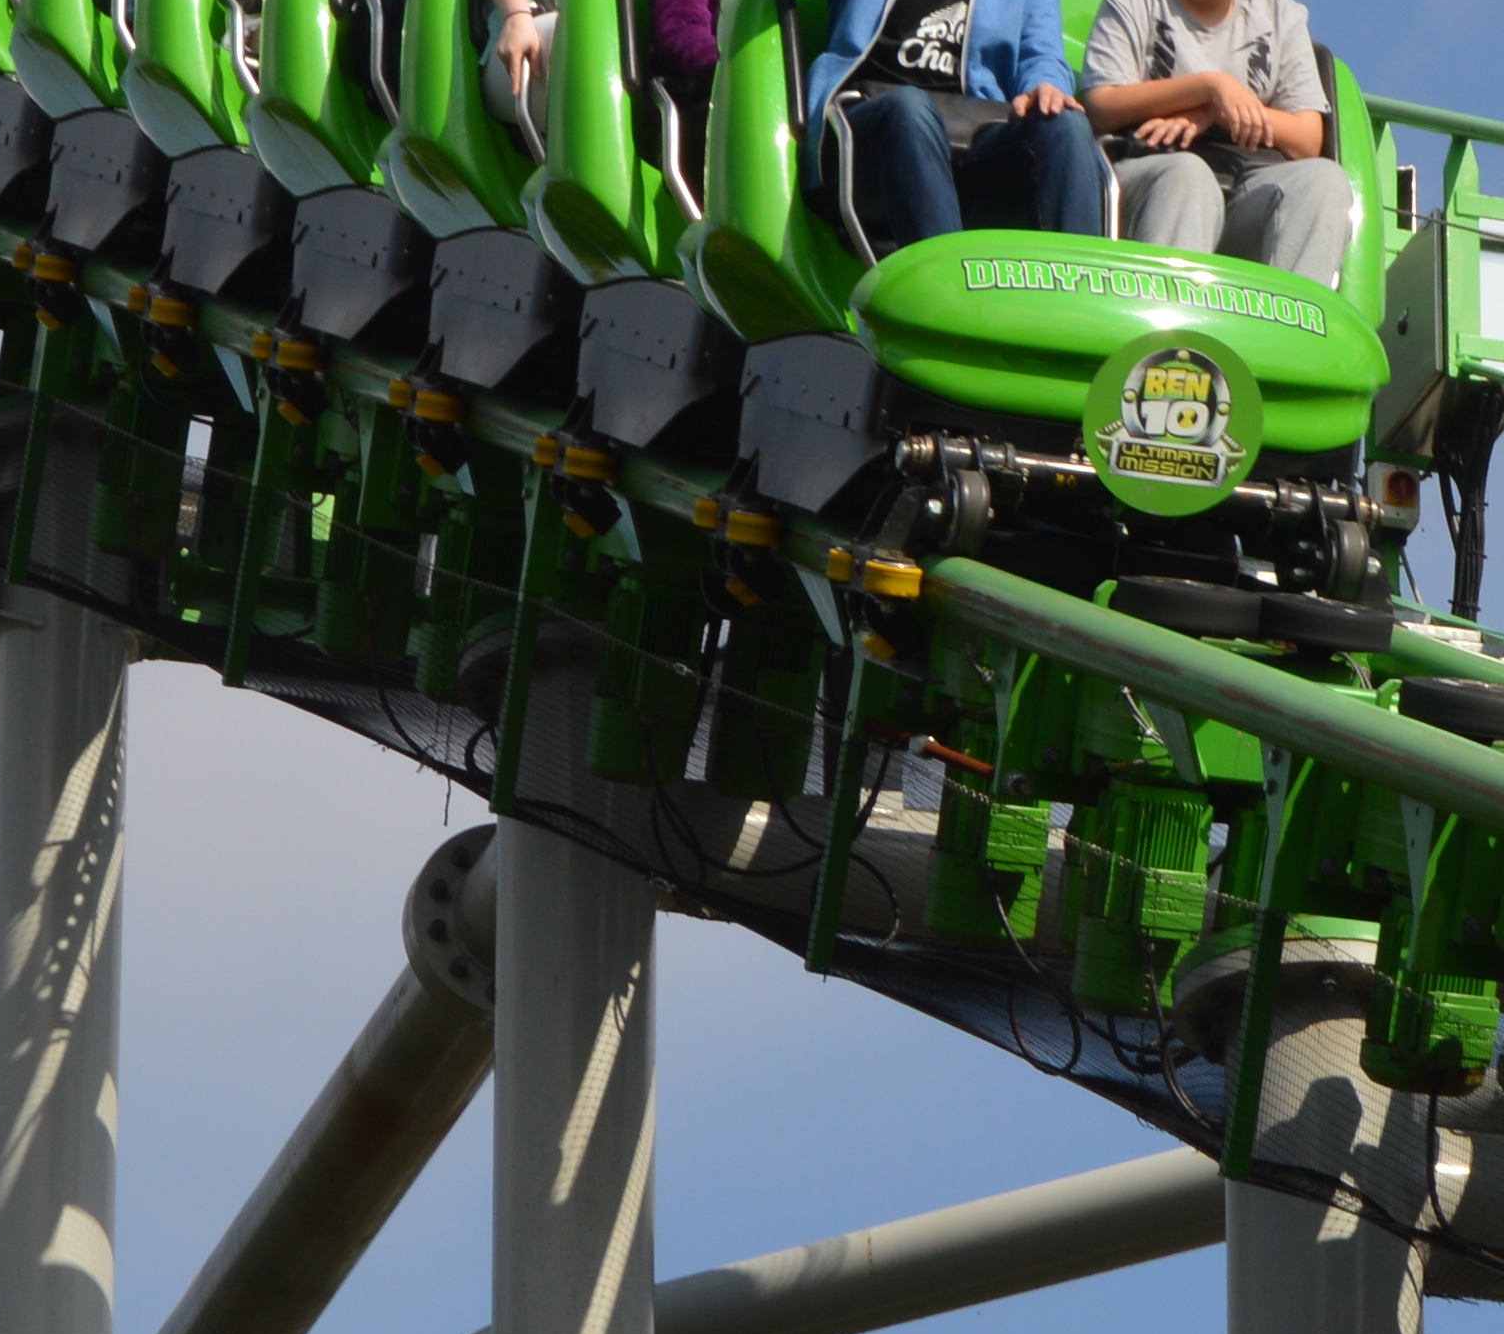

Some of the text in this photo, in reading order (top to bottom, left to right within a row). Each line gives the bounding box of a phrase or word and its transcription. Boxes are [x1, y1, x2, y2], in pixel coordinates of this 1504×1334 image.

[962, 259, 1327, 337] DRAYTON MANOR
[1143, 367, 1212, 402] BEN
[1140, 400, 1210, 437] 10
[1118, 456, 1215, 481] MISSION
[1121, 443, 1218, 465] ULTIMATE
